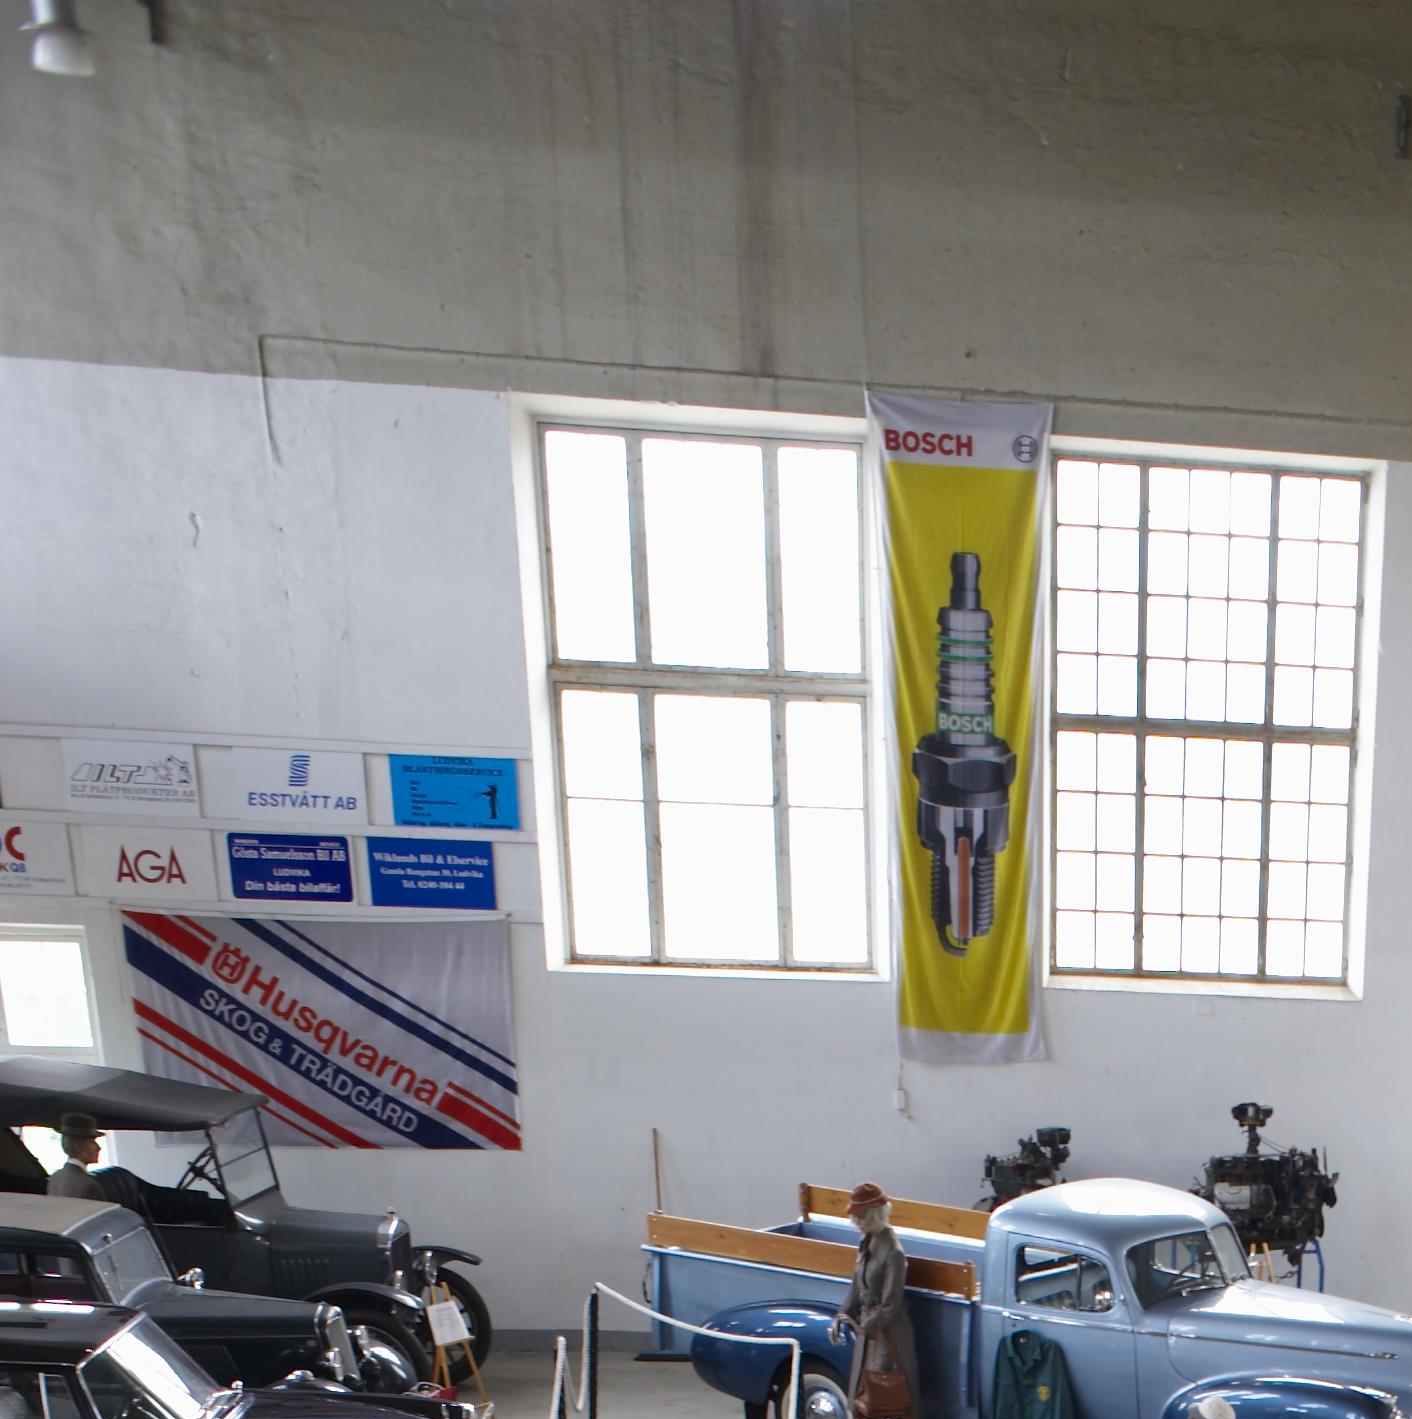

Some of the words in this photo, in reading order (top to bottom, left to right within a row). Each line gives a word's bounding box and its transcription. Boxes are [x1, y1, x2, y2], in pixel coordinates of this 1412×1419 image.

[884, 428, 974, 457] BOSCH
[939, 711, 992, 733] BOSCH
[247, 791, 331, 809] ESSTVÄTT
[334, 796, 358, 811] AB
[0, 825, 26, 862] C
[116, 844, 188, 885] AGA
[331, 849, 346, 861] AB
[435, 854, 445, 864] &
[0, 862, 27, 873] KQ8
[244, 880, 265, 891] Din
[266, 881, 297, 892] bästa
[241, 964, 440, 1107] Husqvarna
[199, 988, 270, 1046] SKOG
[268, 1038, 283, 1056] &
[287, 1044, 419, 1134] TRÄDGÅRD
